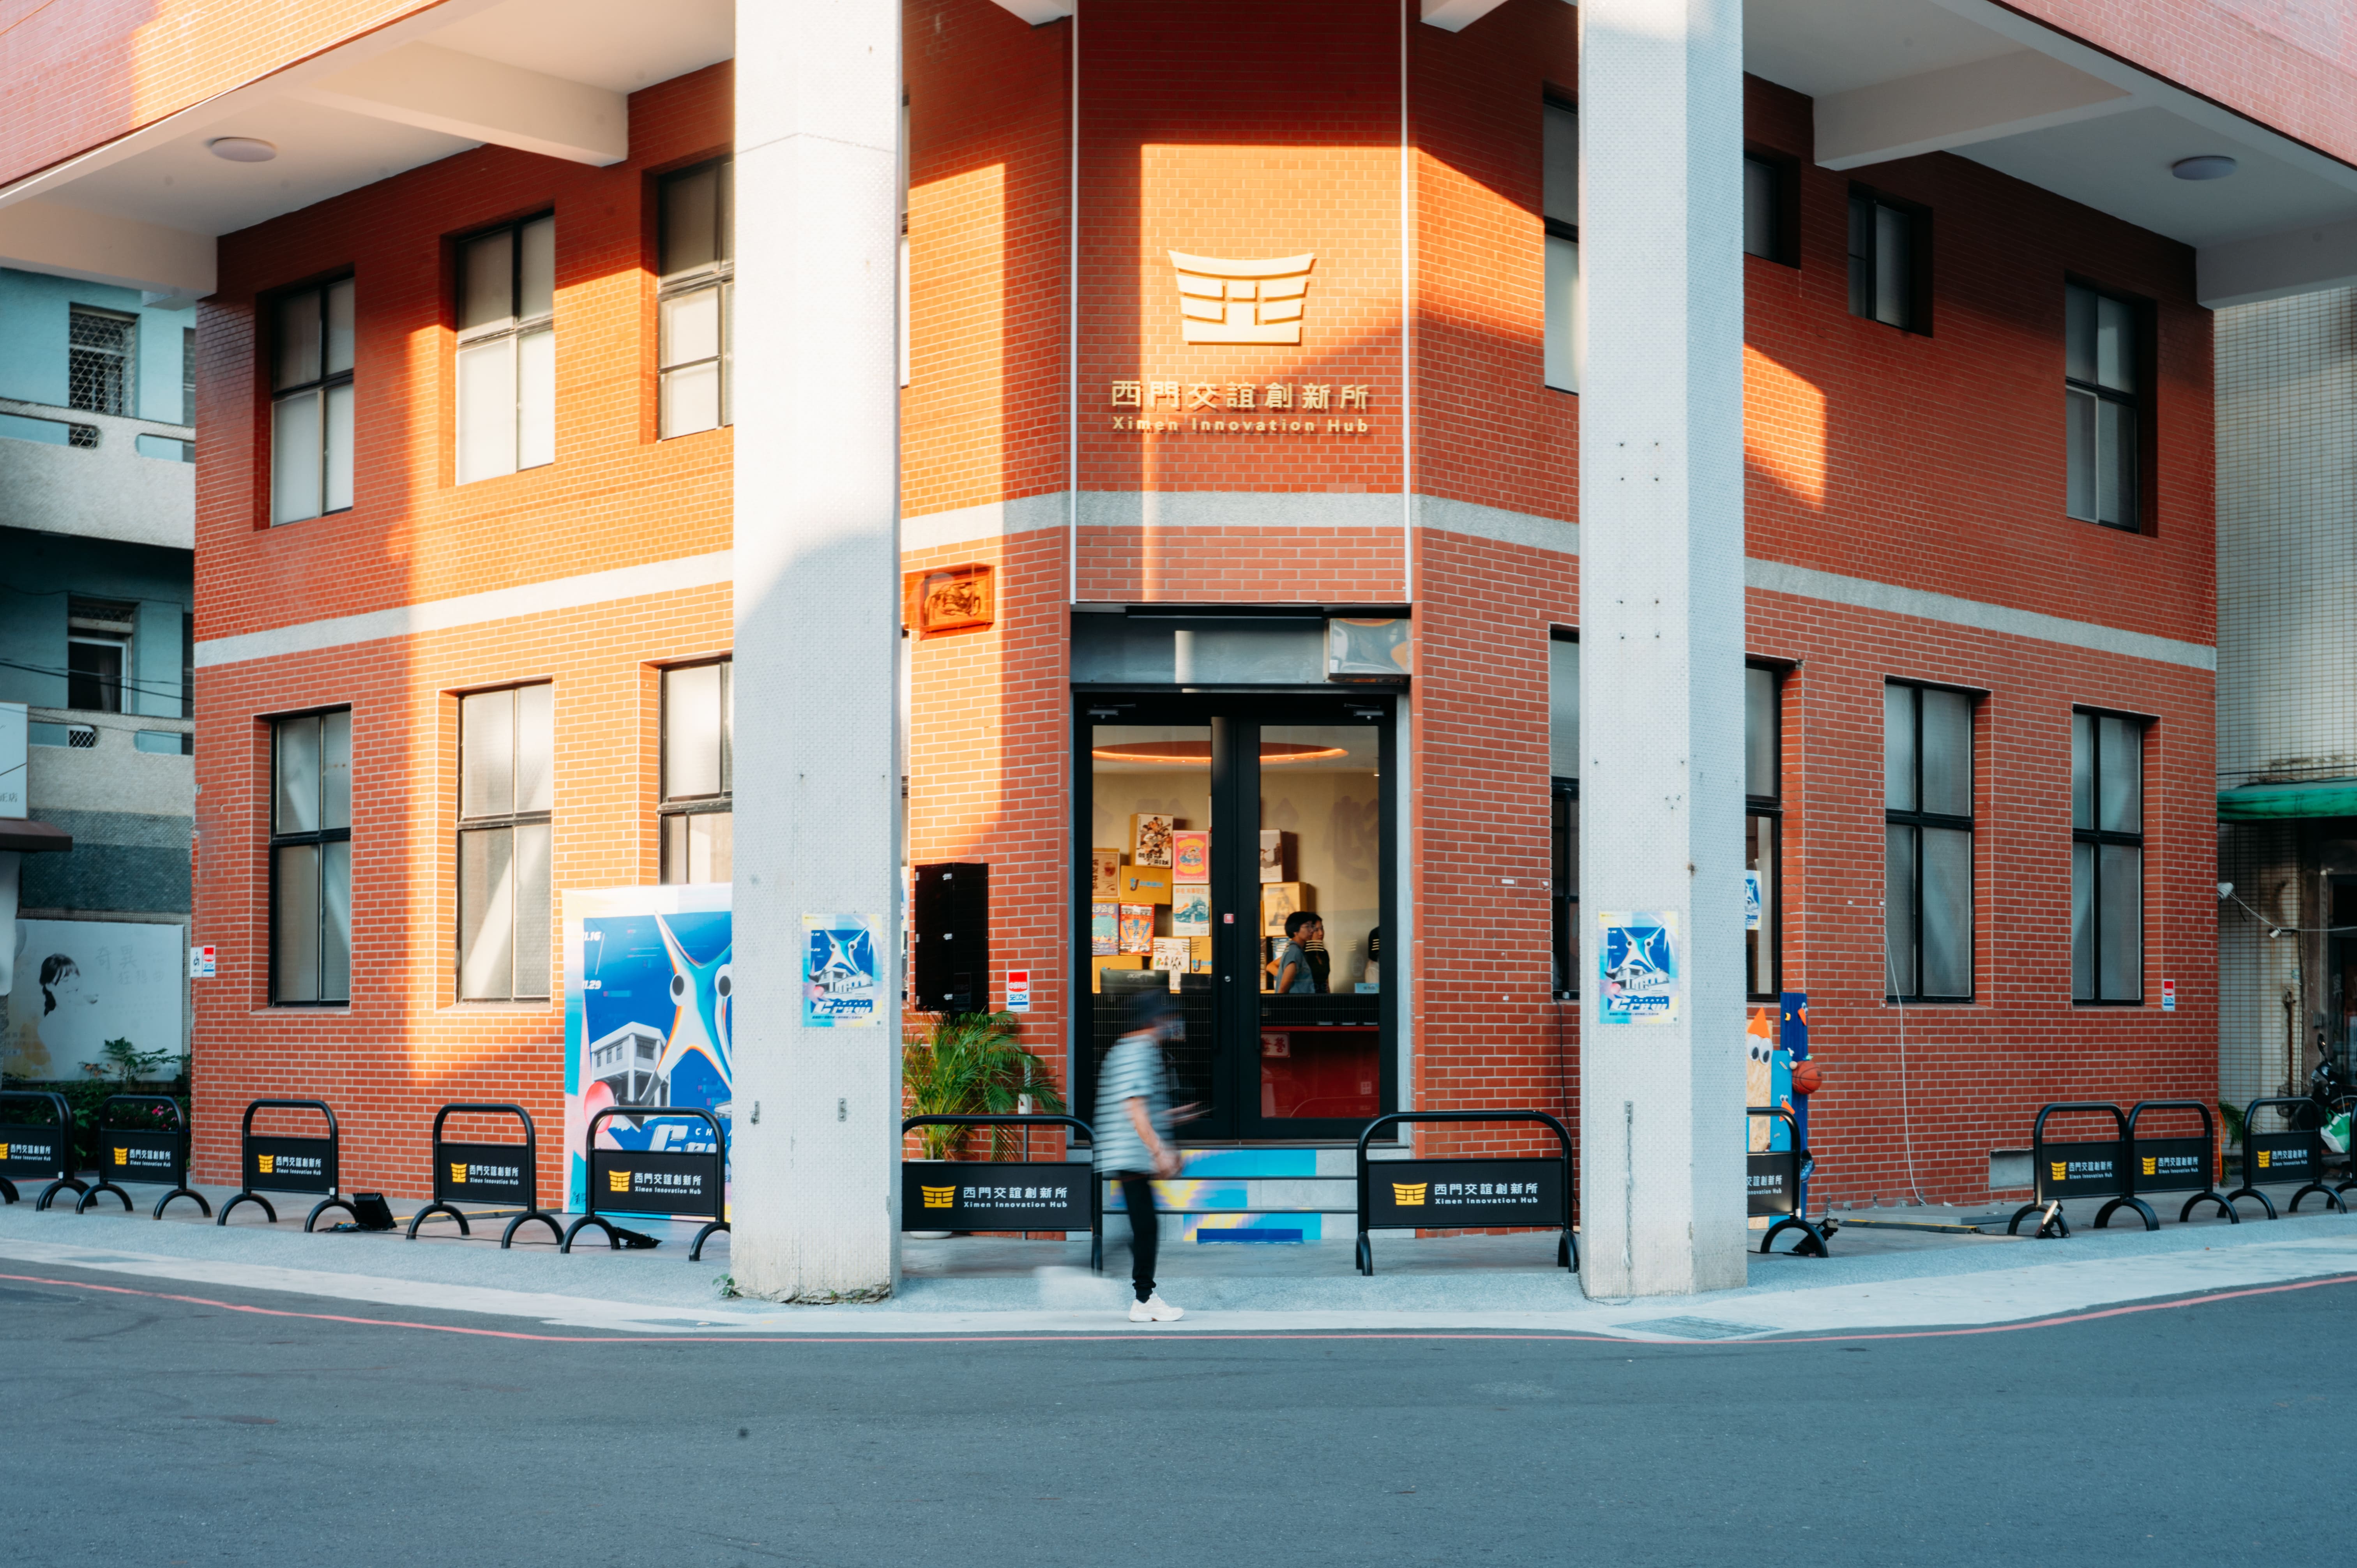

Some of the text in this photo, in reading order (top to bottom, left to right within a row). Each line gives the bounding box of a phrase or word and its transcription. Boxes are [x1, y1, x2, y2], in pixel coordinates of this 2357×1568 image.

[1112, 380, 1369, 409] 西門交誼創新所
[1113, 417, 1368, 432] Ximen Innovation Hub
[812, 1001, 871, 1014] Crew
[1609, 998, 1668, 1010] Crew
[634, 1173, 701, 1186] 西門交誼創新所
[963, 1187, 1067, 1198] 西門交誼創新所
[1435, 1183, 1538, 1195] 西門交誼創新所
